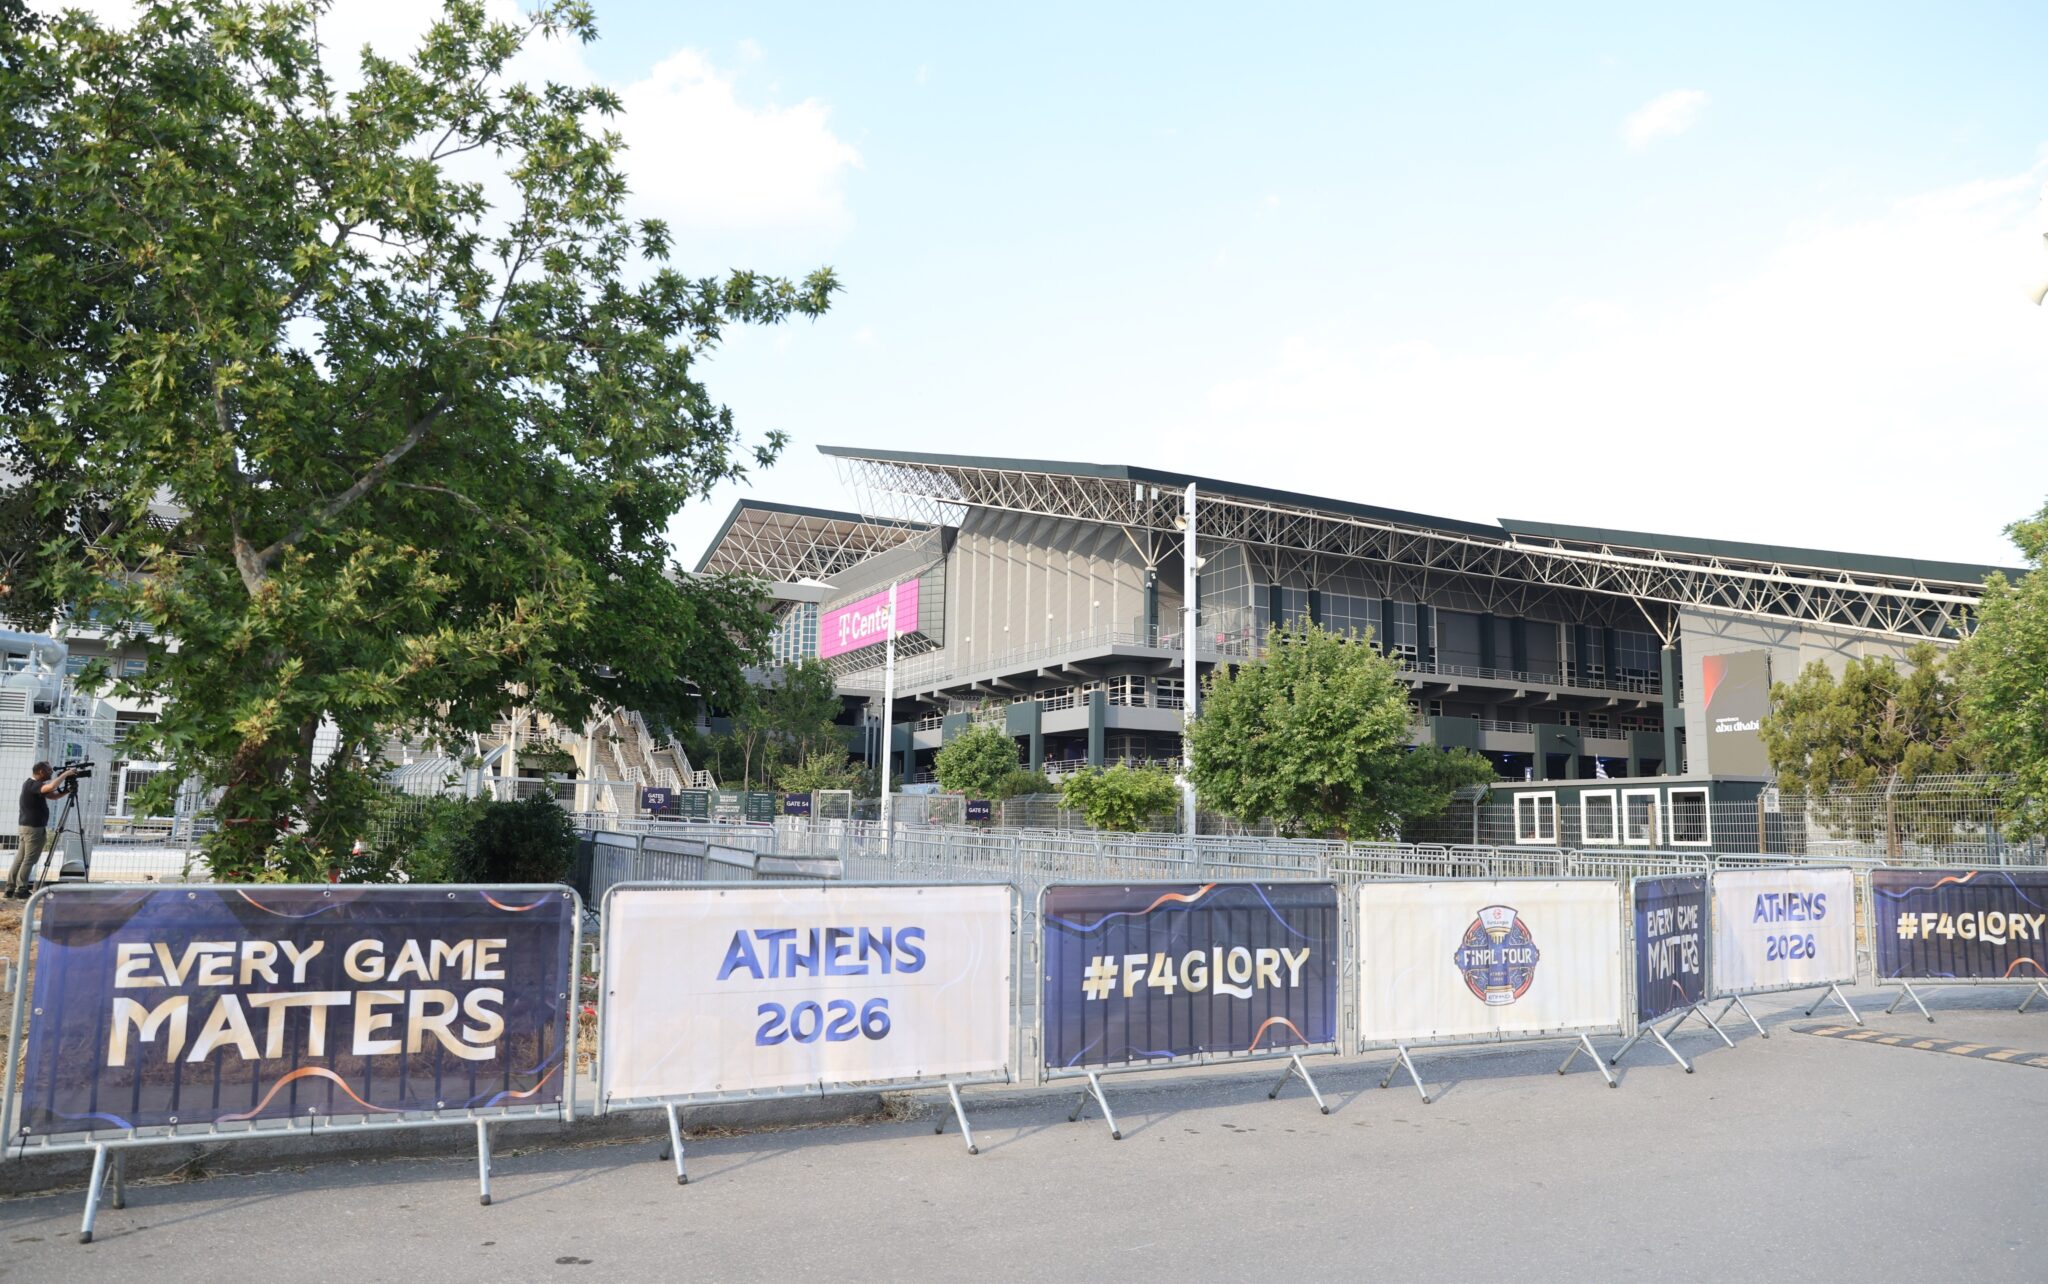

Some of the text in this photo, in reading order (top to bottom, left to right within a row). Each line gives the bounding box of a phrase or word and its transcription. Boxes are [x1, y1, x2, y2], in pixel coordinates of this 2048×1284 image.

[852, 605, 889, 639] Cente
[1715, 720, 1760, 733] abu dhabi
[1647, 905, 1698, 938] EVERY GAME
[1752, 892, 1827, 924] ATHENS
[1896, 911, 2047, 945] #F4GLORY
[114, 938, 508, 989] EVERY GAME
[716, 926, 926, 981] ATHENS
[1502, 948, 1533, 965] FOUR
[1647, 933, 1699, 983] MATTERS
[1766, 934, 1816, 962] 2026
[1082, 946, 1310, 1000] #F4GLORY
[106, 988, 506, 1068] MATTERS
[755, 997, 891, 1047] 2026
